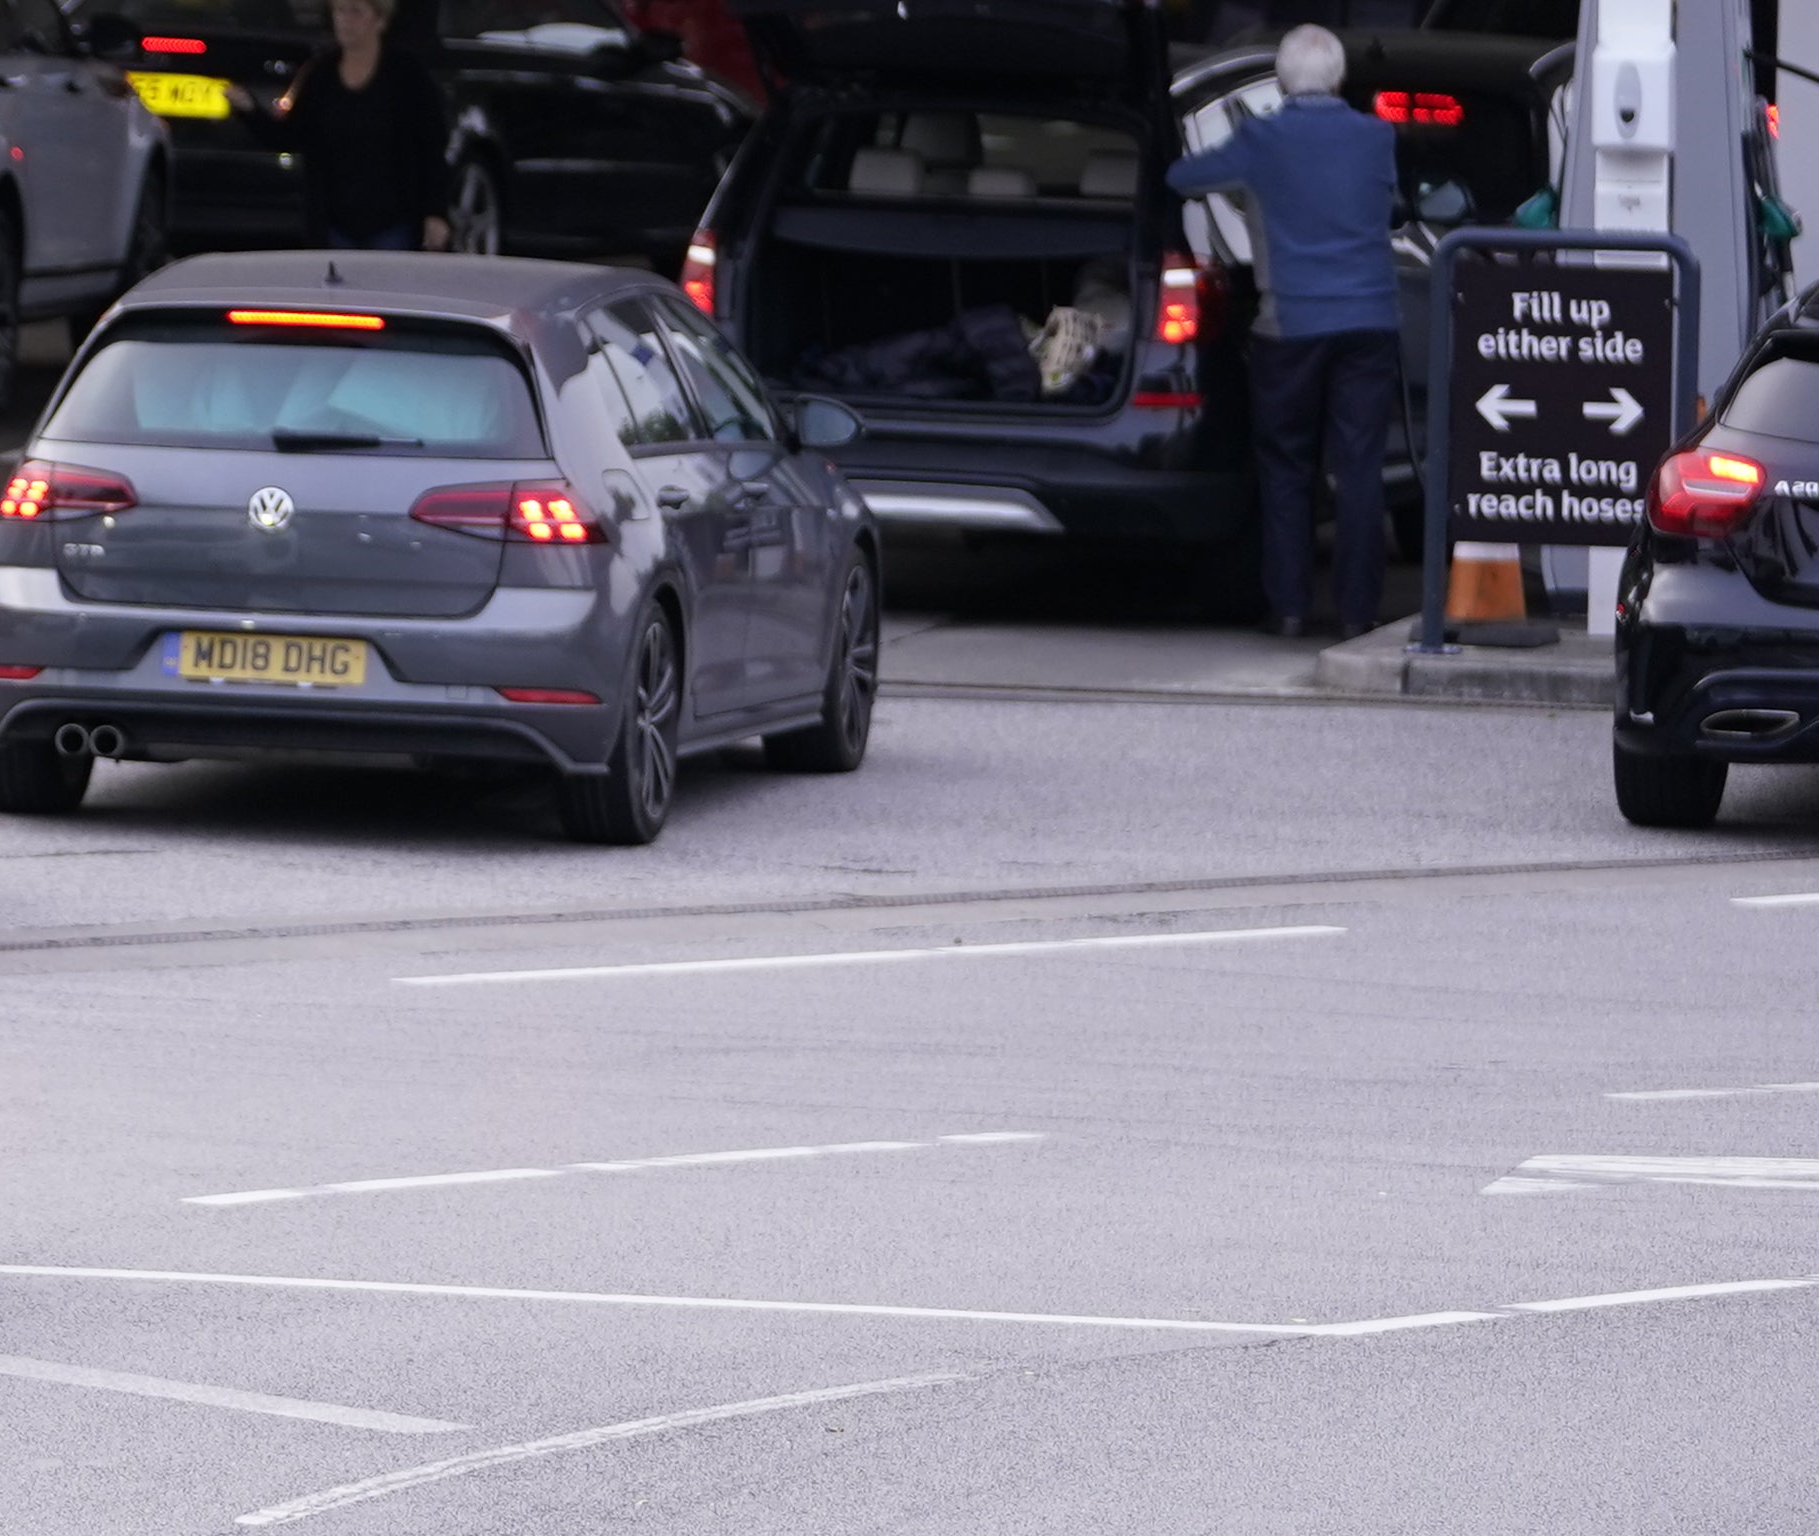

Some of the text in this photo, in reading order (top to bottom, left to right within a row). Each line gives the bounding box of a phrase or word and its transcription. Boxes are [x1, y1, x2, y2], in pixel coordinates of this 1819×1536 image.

[1511, 290, 1612, 330] Fill up
[1476, 327, 1645, 364] either side
[1479, 450, 1639, 492] Extra long
[1466, 488, 1648, 525] reach hoses
[192, 635, 351, 676] MD18 DHG
